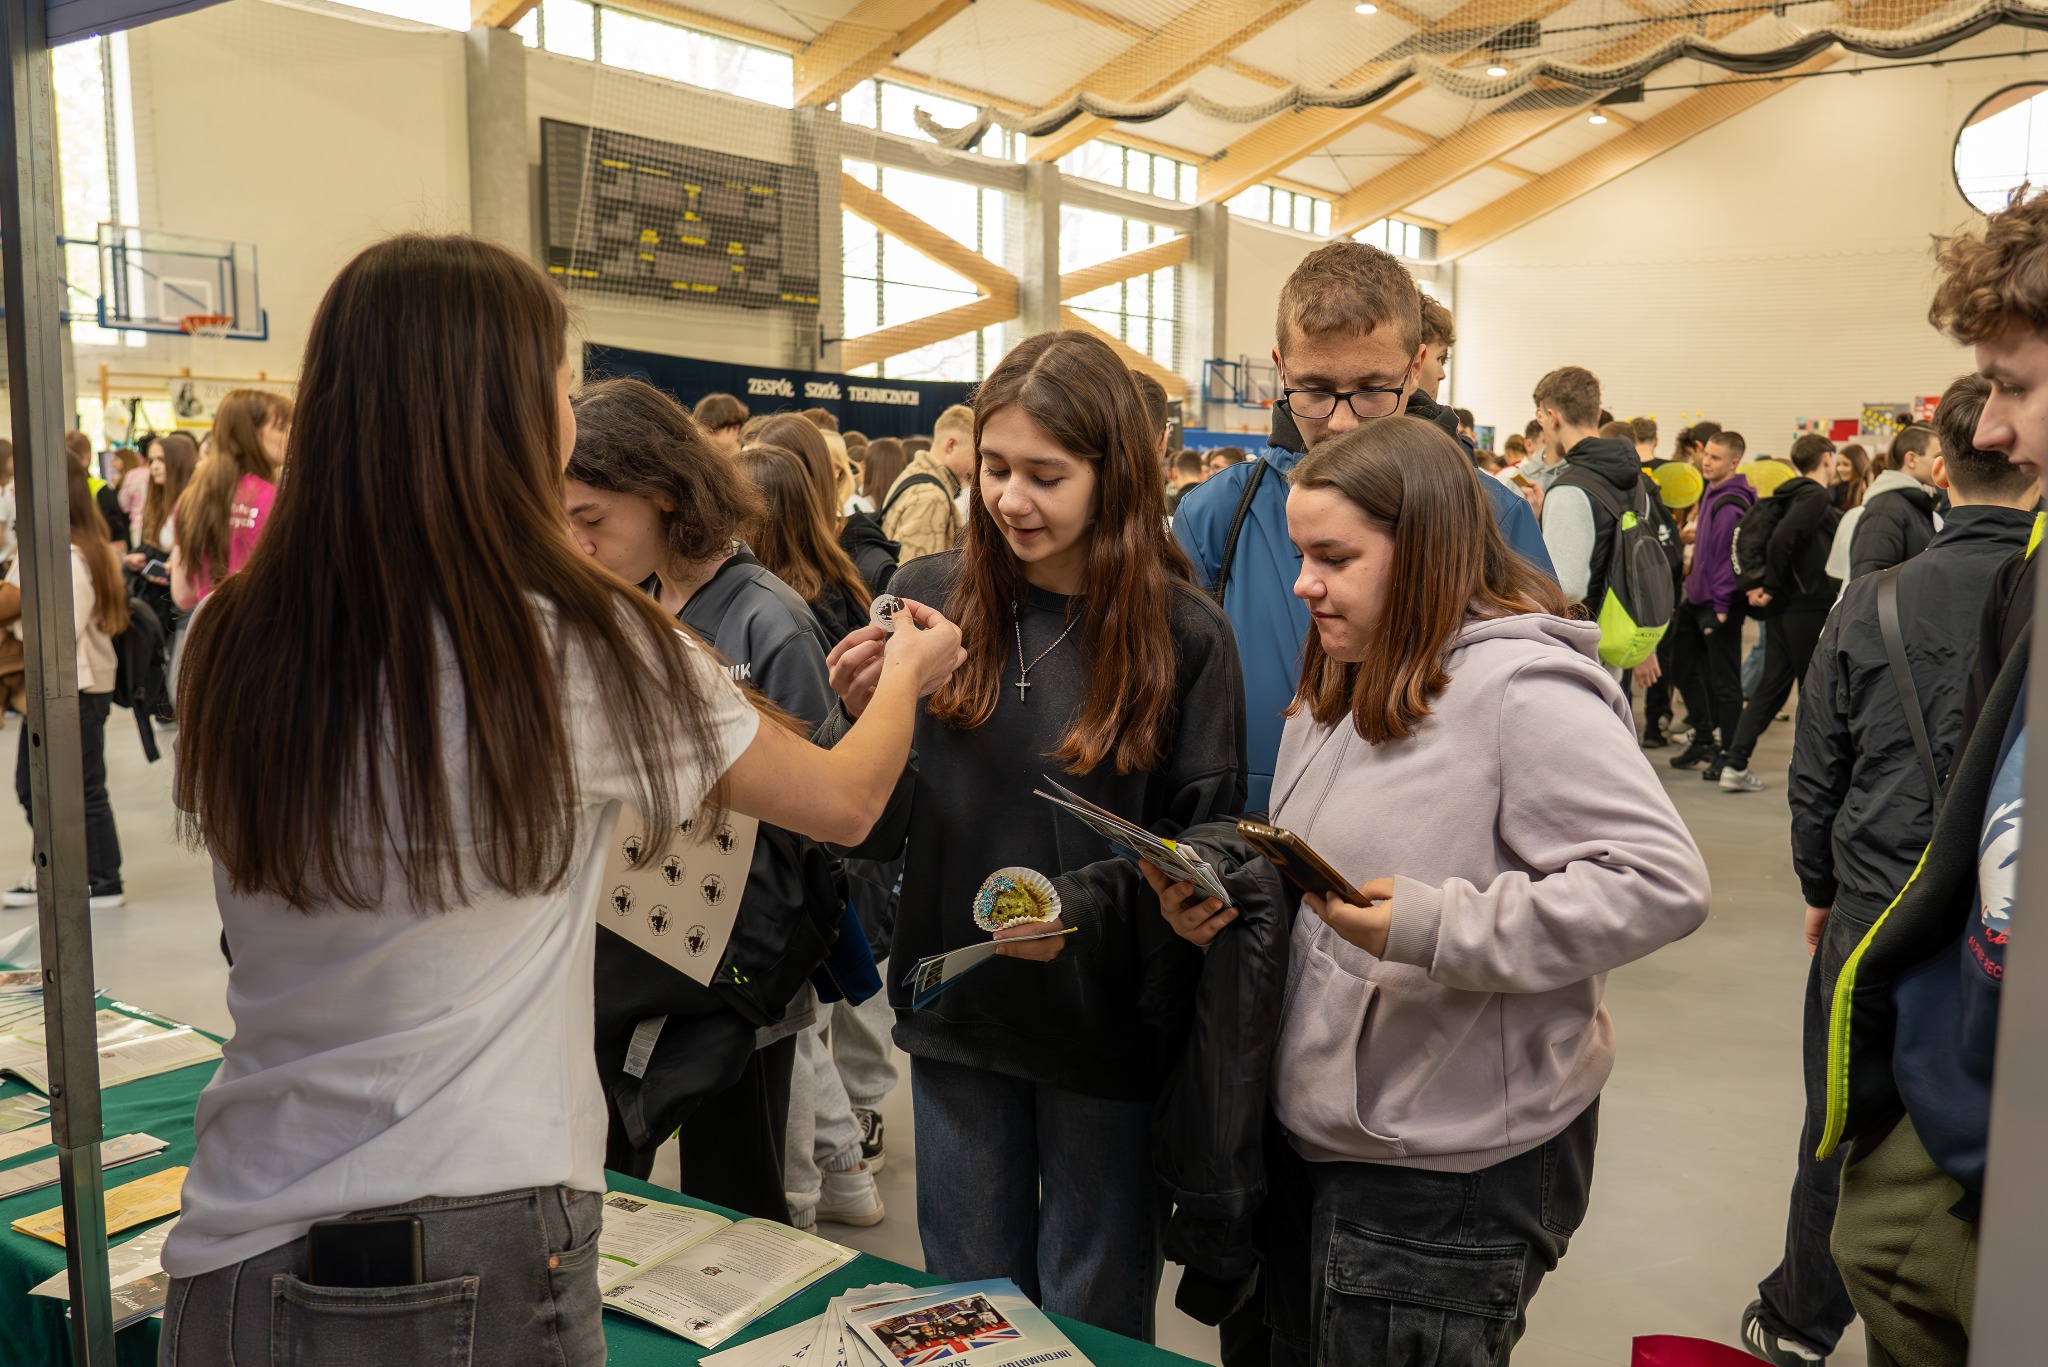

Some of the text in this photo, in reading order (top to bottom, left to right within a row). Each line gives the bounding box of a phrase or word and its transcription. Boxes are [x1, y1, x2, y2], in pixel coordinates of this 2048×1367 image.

[748, 377, 920, 406] ZESPÓŁ SZKÓŁ TECHNICZNYCH
[722, 662, 751, 680] NIK
